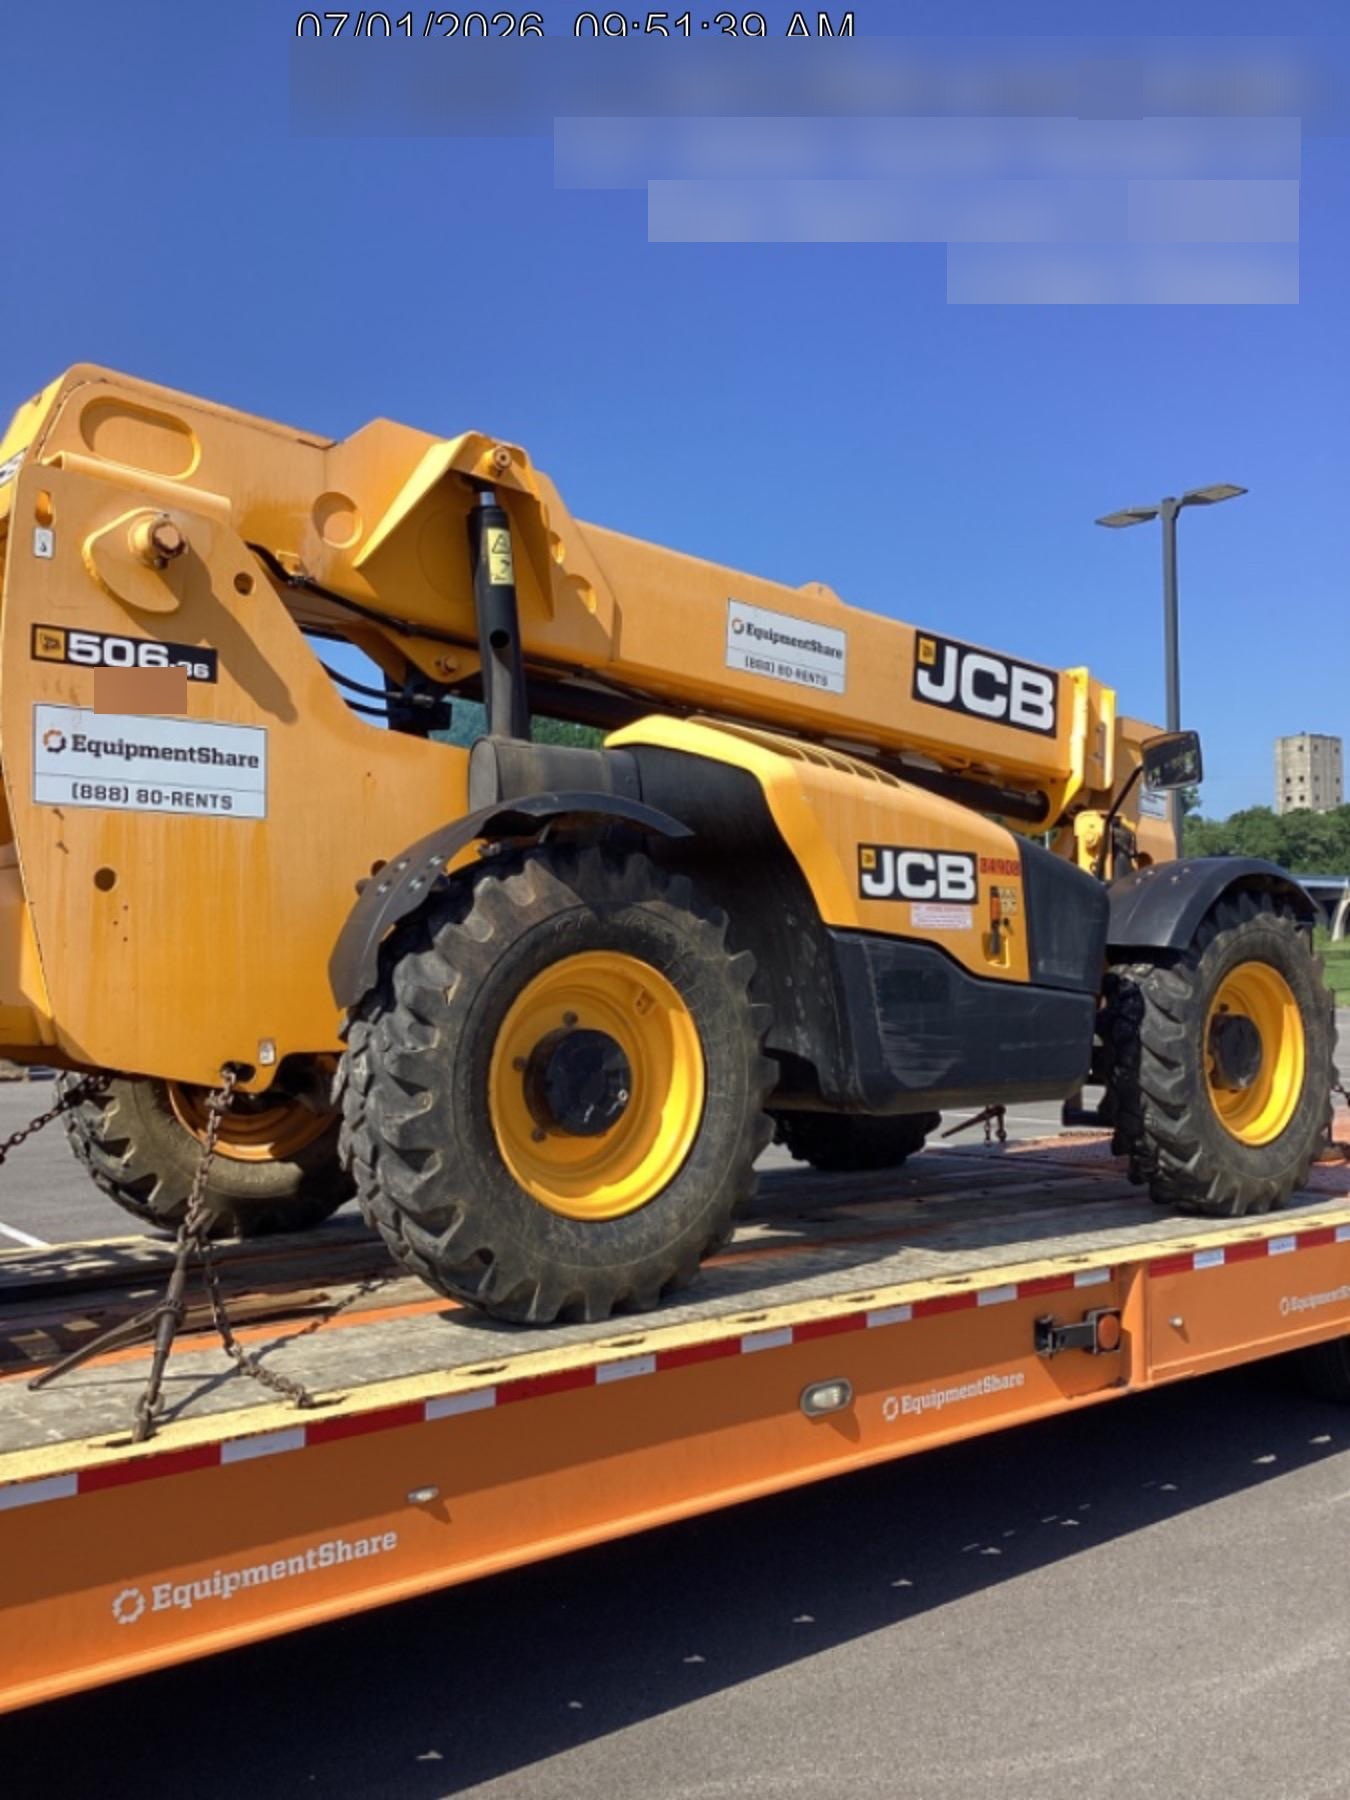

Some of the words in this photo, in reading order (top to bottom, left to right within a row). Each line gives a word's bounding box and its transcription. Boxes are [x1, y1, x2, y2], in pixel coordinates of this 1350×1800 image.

[916, 645, 1055, 731] JCB
[71, 733, 260, 769] EquipmentShare
[71, 781, 130, 804] (888)
[136, 789, 233, 810] 80-RENTS
[861, 850, 976, 900] JCB
[901, 1372, 1025, 1415] EquipmentShare
[151, 1530, 398, 1612] EquipmentShare
